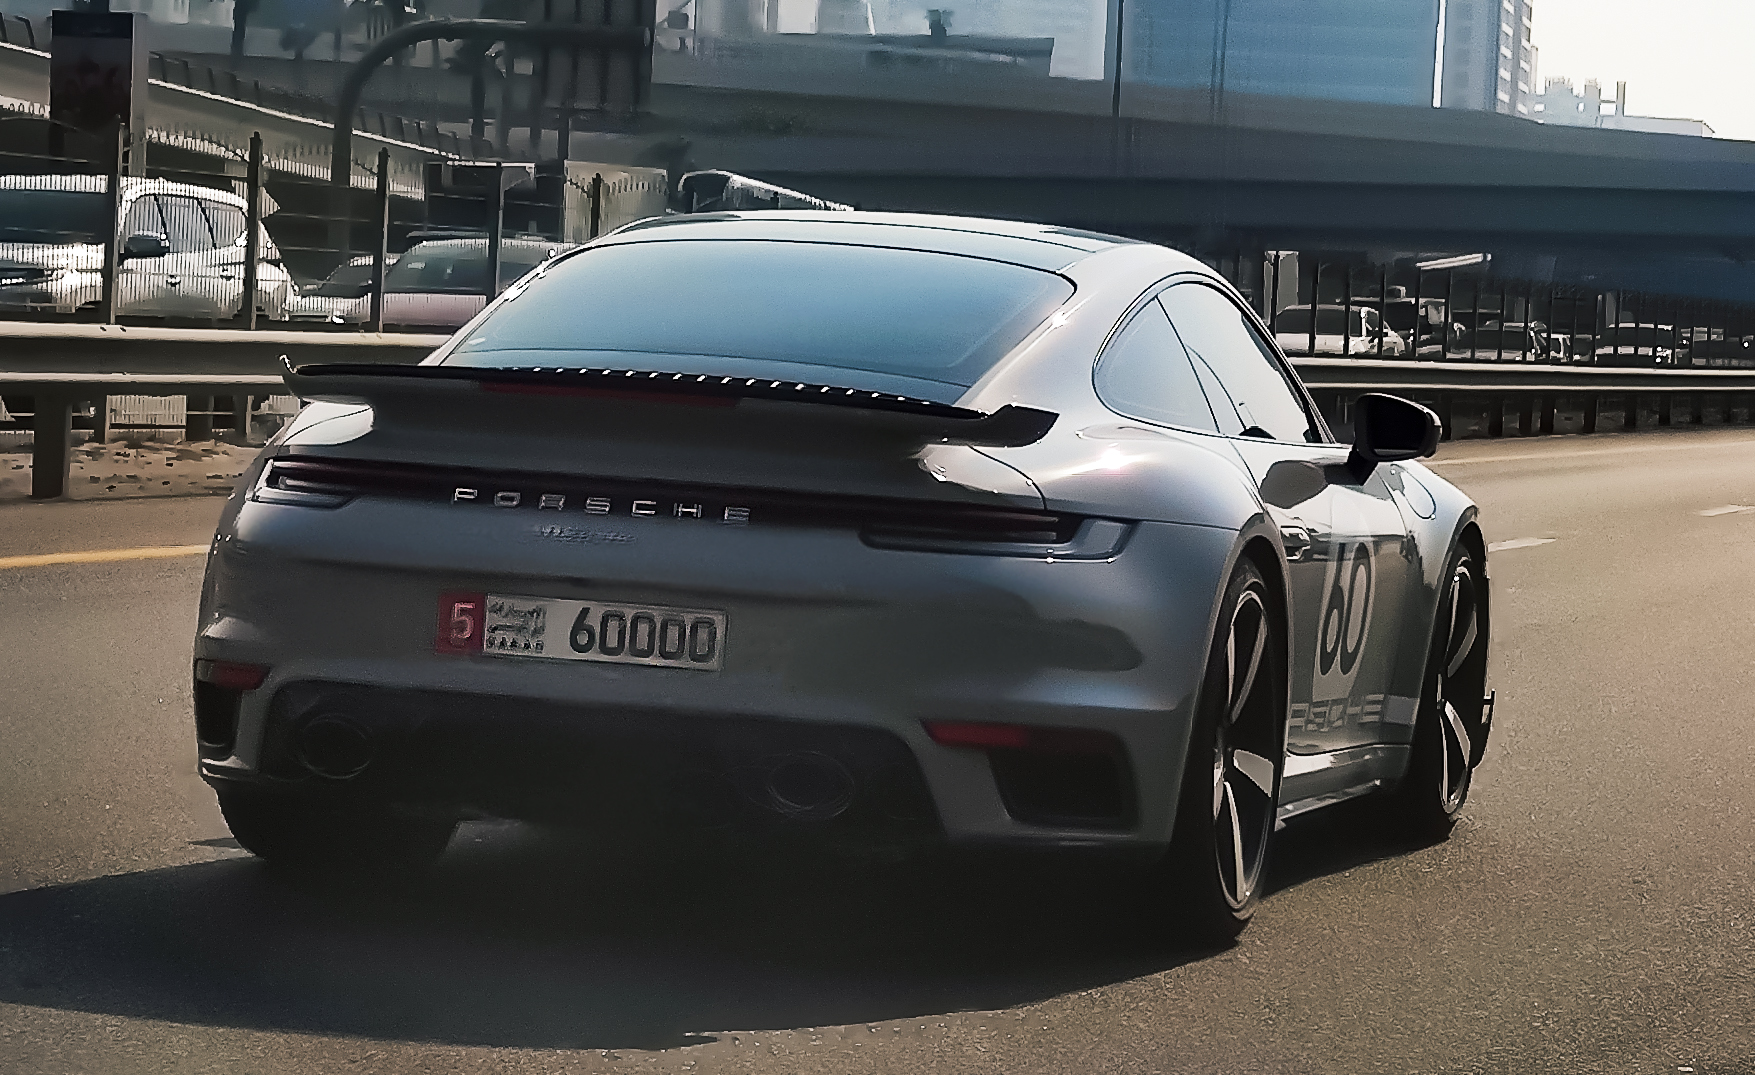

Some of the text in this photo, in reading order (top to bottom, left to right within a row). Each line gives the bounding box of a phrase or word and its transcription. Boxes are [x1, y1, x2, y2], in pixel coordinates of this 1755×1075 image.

[451, 487, 749, 524] PORSCHE
[449, 601, 477, 647] 5
[568, 606, 718, 664] 60000
[1319, 542, 1372, 677] 60
